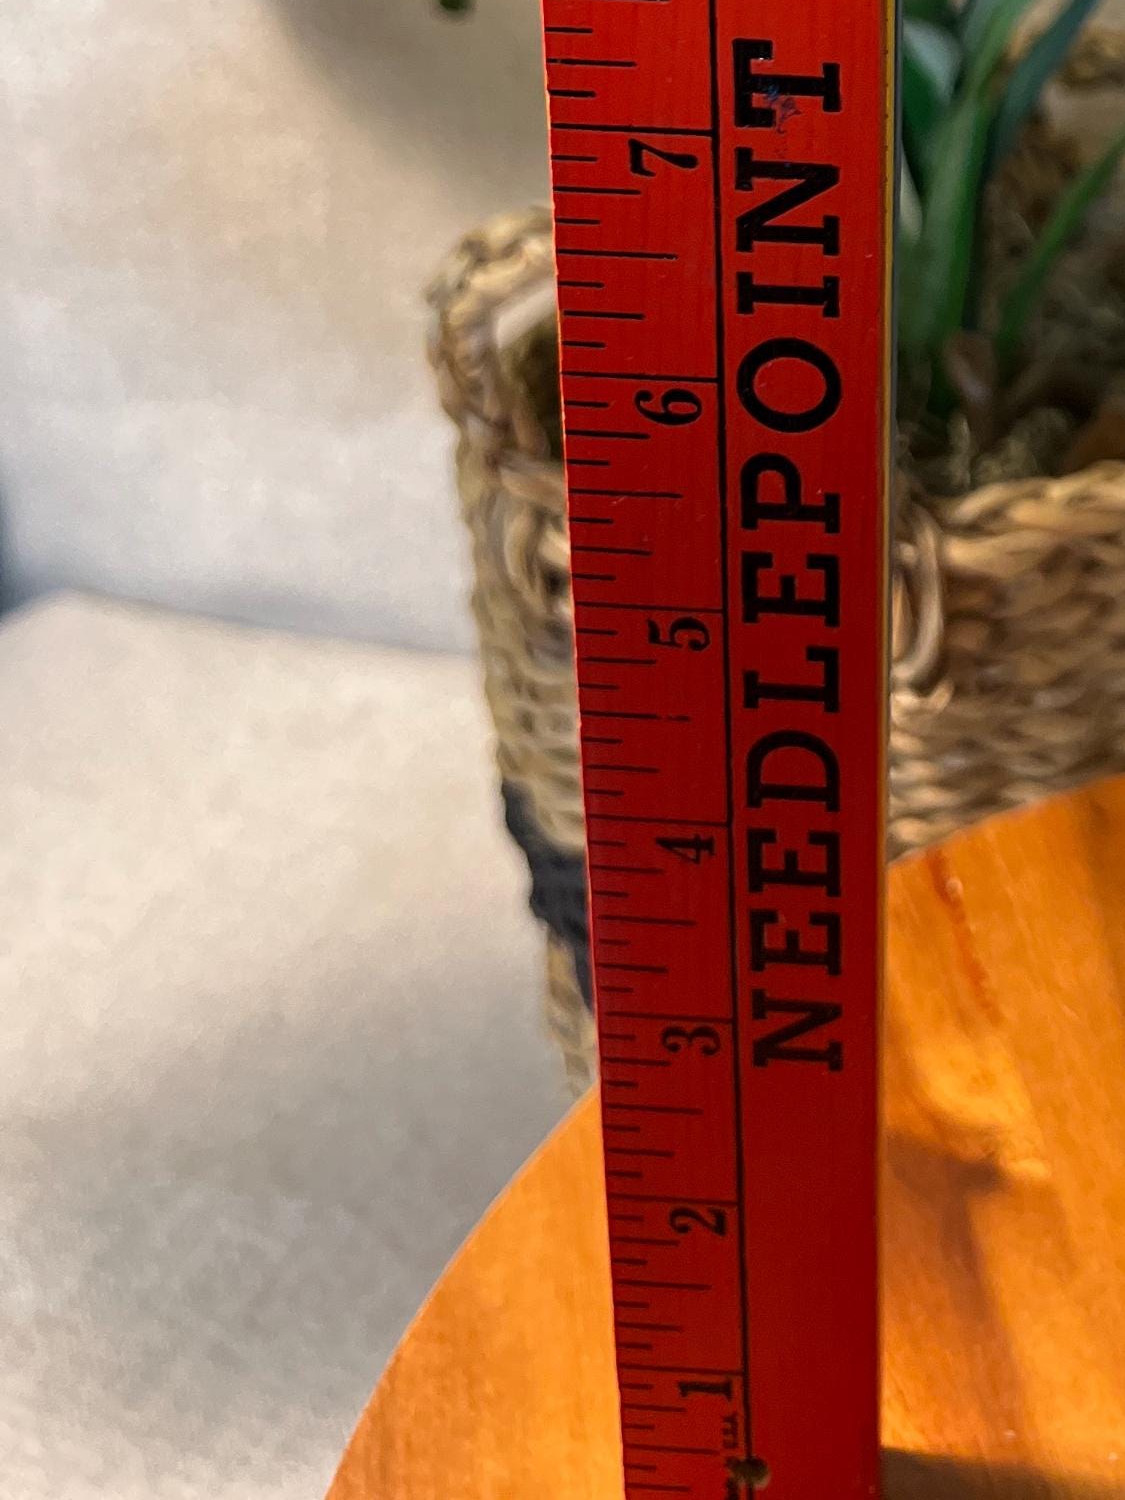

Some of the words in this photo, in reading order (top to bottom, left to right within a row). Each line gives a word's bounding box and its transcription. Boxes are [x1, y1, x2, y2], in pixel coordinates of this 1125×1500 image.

[628, 138, 699, 177] 7
[634, 388, 703, 426] 6
[731, 38, 843, 1073] NEEDLEPOINT
[646, 616, 711, 652] 5
[656, 834, 716, 865] 4
[660, 1025, 722, 1056] 3
[669, 1206, 728, 1237] 2
[678, 1379, 732, 1401] 1
